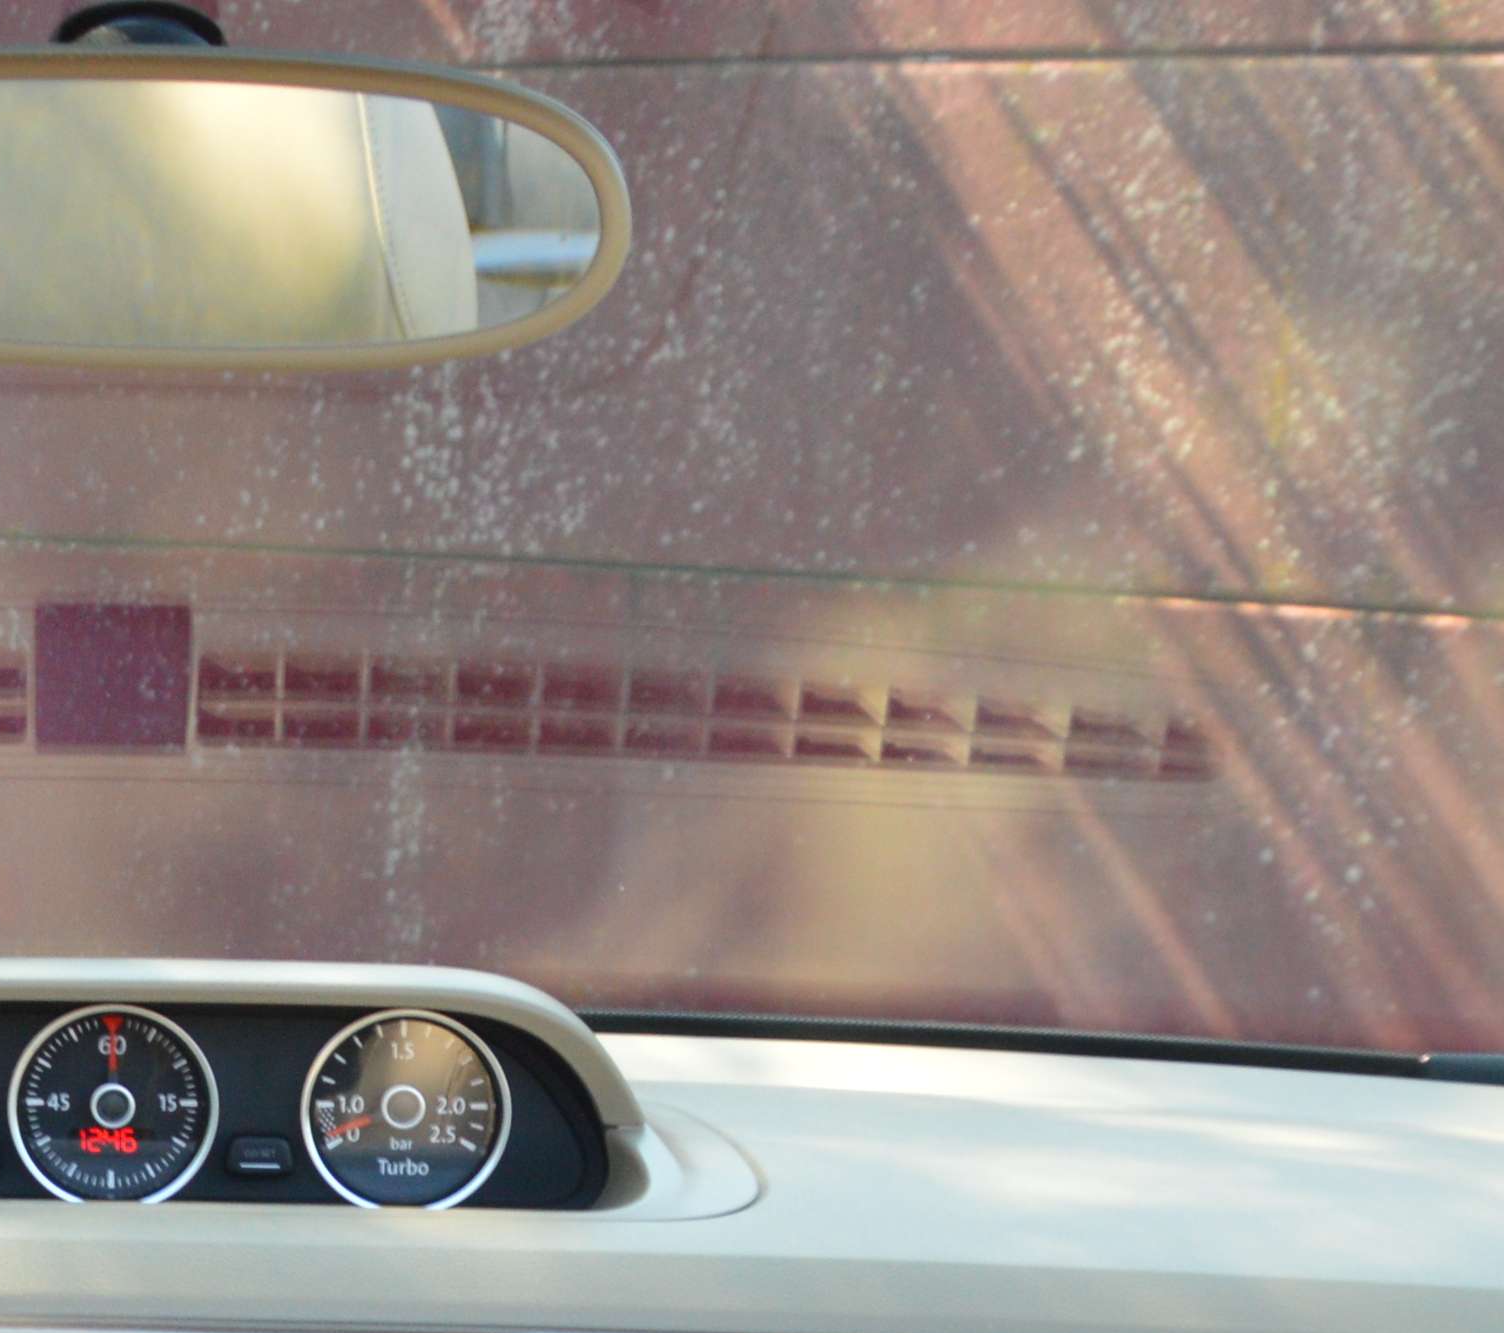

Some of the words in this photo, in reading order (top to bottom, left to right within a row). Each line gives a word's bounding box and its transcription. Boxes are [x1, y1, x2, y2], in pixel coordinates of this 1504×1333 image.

[98, 1035, 127, 1056] 60
[391, 1042, 415, 1060] 1.5
[47, 1093, 71, 1111] 45
[158, 1093, 178, 1112] 15
[339, 1095, 365, 1113] 1.0
[437, 1097, 466, 1114] 2.0
[390, 1137, 412, 1150] bar
[430, 1126, 456, 1143] 2.5
[377, 1157, 430, 1176] Turbo
